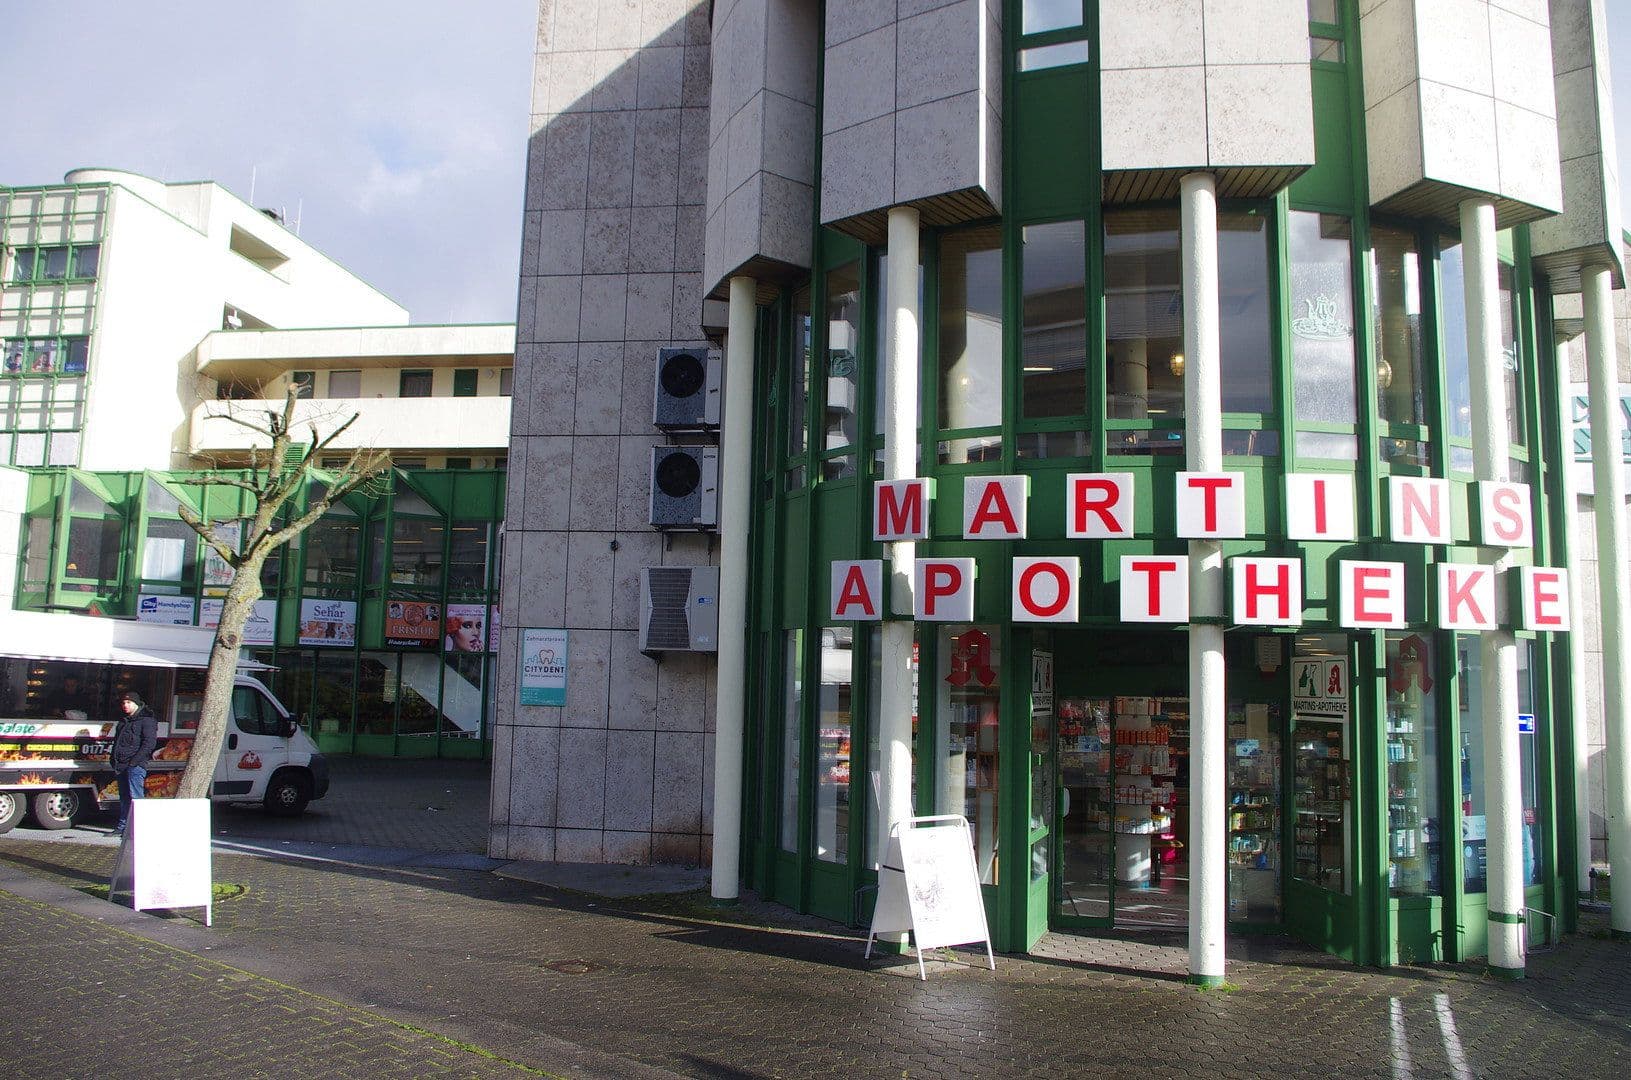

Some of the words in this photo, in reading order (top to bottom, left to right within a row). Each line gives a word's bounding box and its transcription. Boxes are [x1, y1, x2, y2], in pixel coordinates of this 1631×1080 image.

[877, 477, 1524, 542] MARTINS
[836, 561, 1562, 625] APOTHEKE
[158, 601, 192, 609] Handyshop
[313, 605, 346, 618] Sehar
[391, 625, 435, 635] FRISEUR
[524, 665, 565, 673] CITYDENT
[1293, 700, 1347, 712] MARTINS-APOTHEKE
